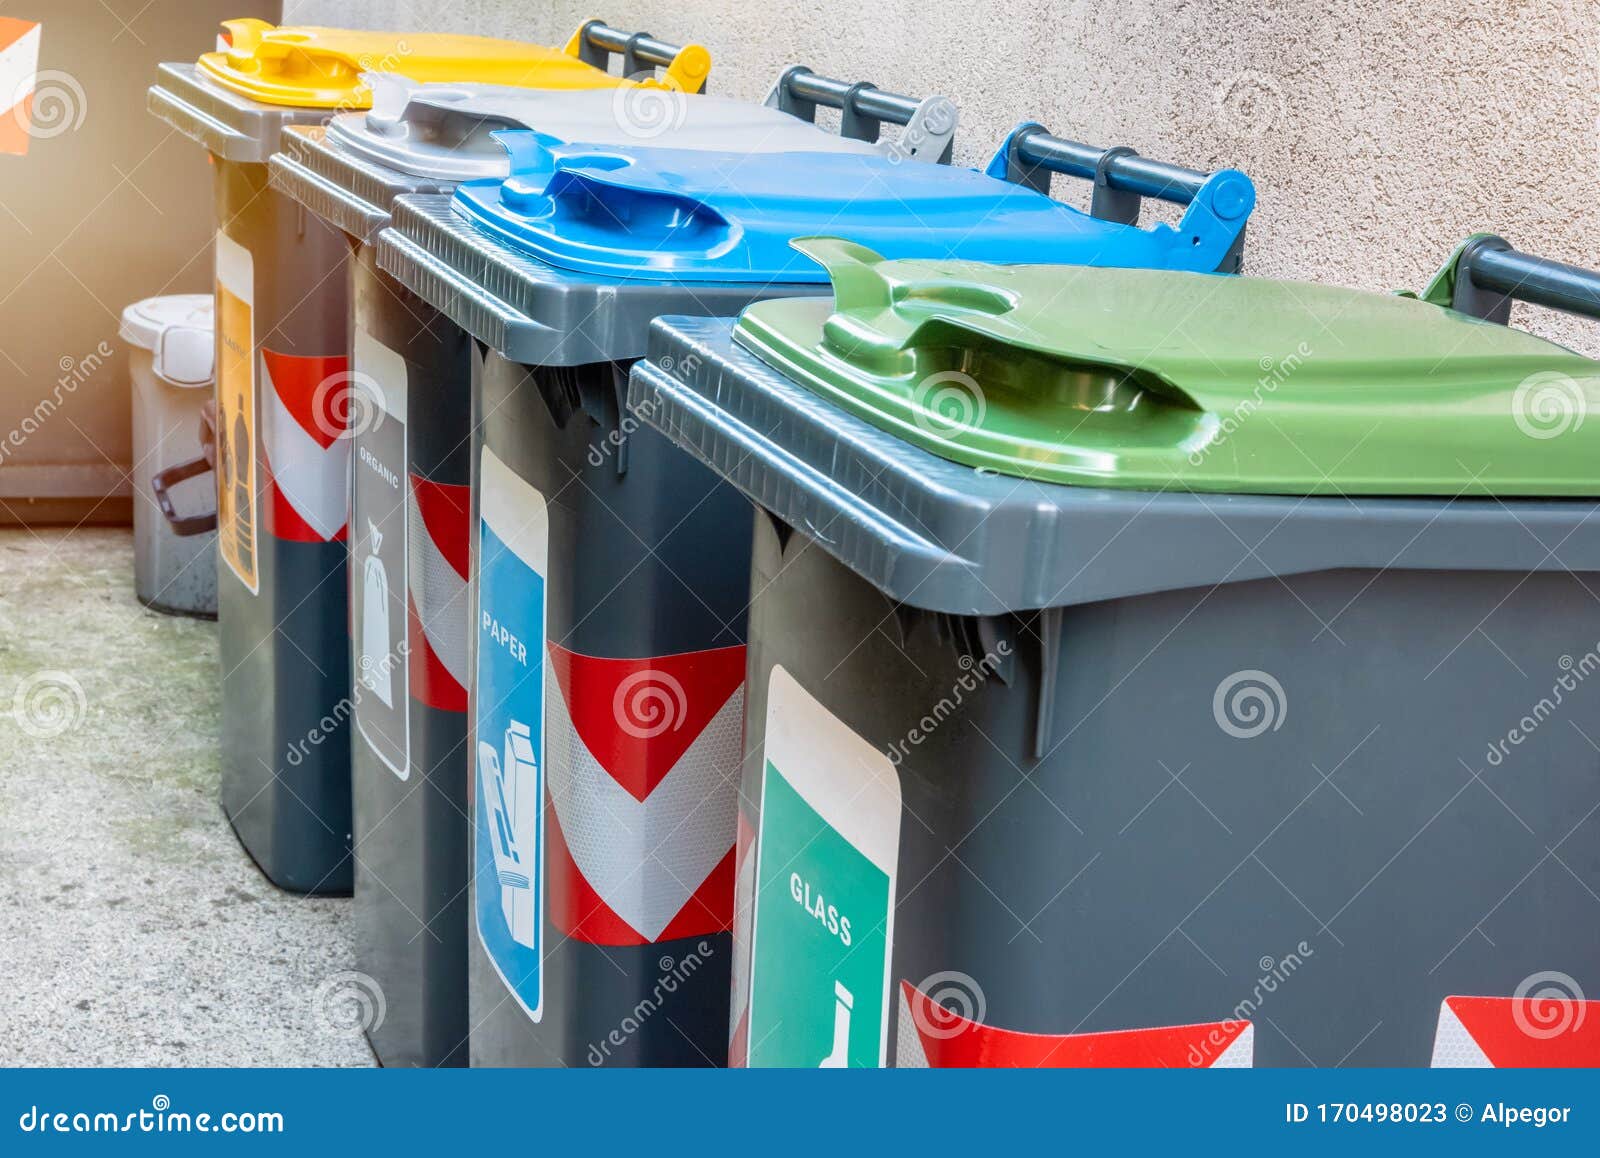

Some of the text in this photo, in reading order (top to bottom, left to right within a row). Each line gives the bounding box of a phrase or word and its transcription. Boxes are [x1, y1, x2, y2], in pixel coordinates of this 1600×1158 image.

[360, 446, 399, 489] ORGANIC
[482, 609, 528, 667] PAPER
[790, 872, 852, 947] GLASS
